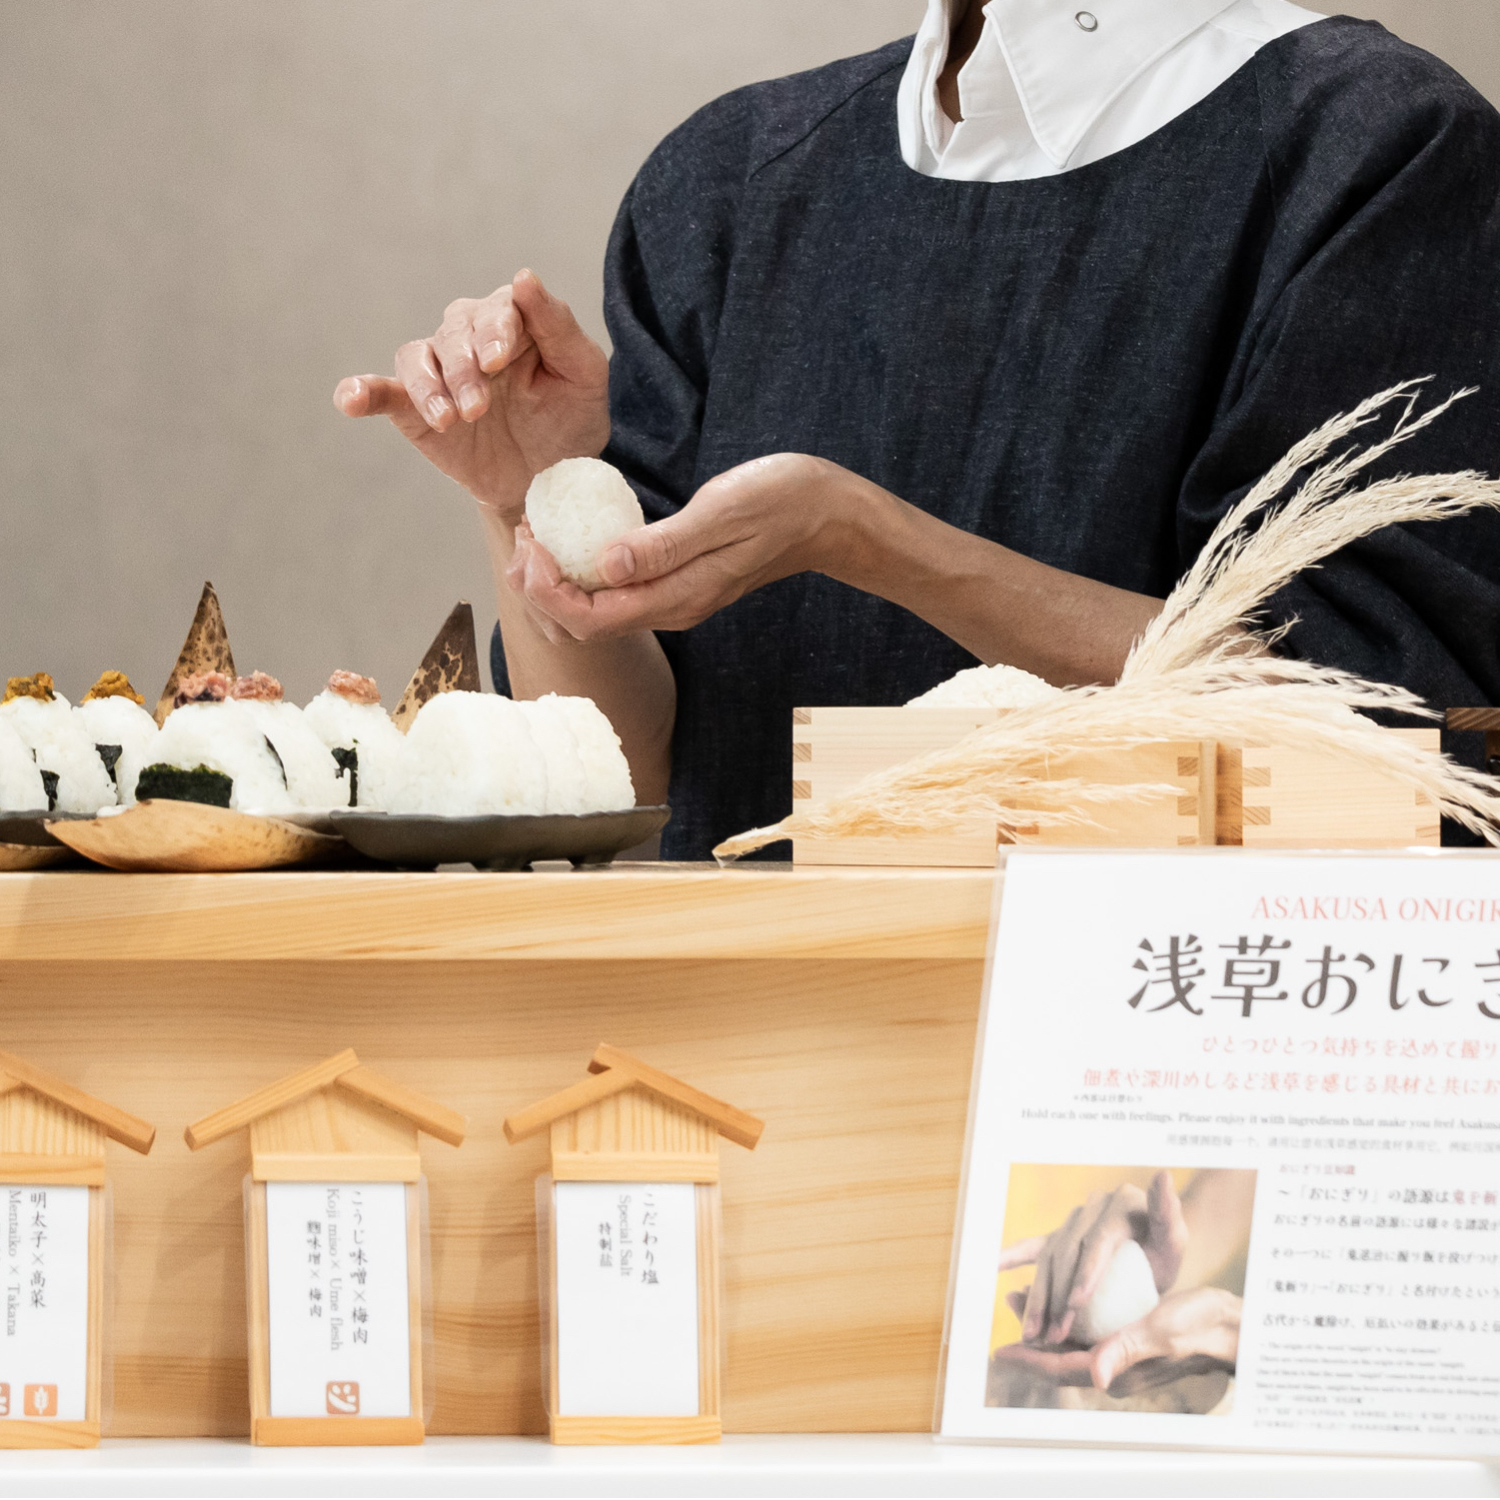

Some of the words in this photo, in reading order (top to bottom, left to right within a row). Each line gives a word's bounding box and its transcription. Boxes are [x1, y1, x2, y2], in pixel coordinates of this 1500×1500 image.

[1251, 895, 1389, 922] ASAKUSA
[1102, 1110, 1127, 1121] with
[325, 1187, 340, 1219] Koji
[616, 1194, 632, 1245] Special
[8, 1189, 22, 1257] Mentaiko
[641, 1193, 660, 1285] こだわり塩
[619, 1248, 634, 1277] Salt
[7, 1285, 22, 1337] Takana
[329, 1278, 343, 1312] Ume
